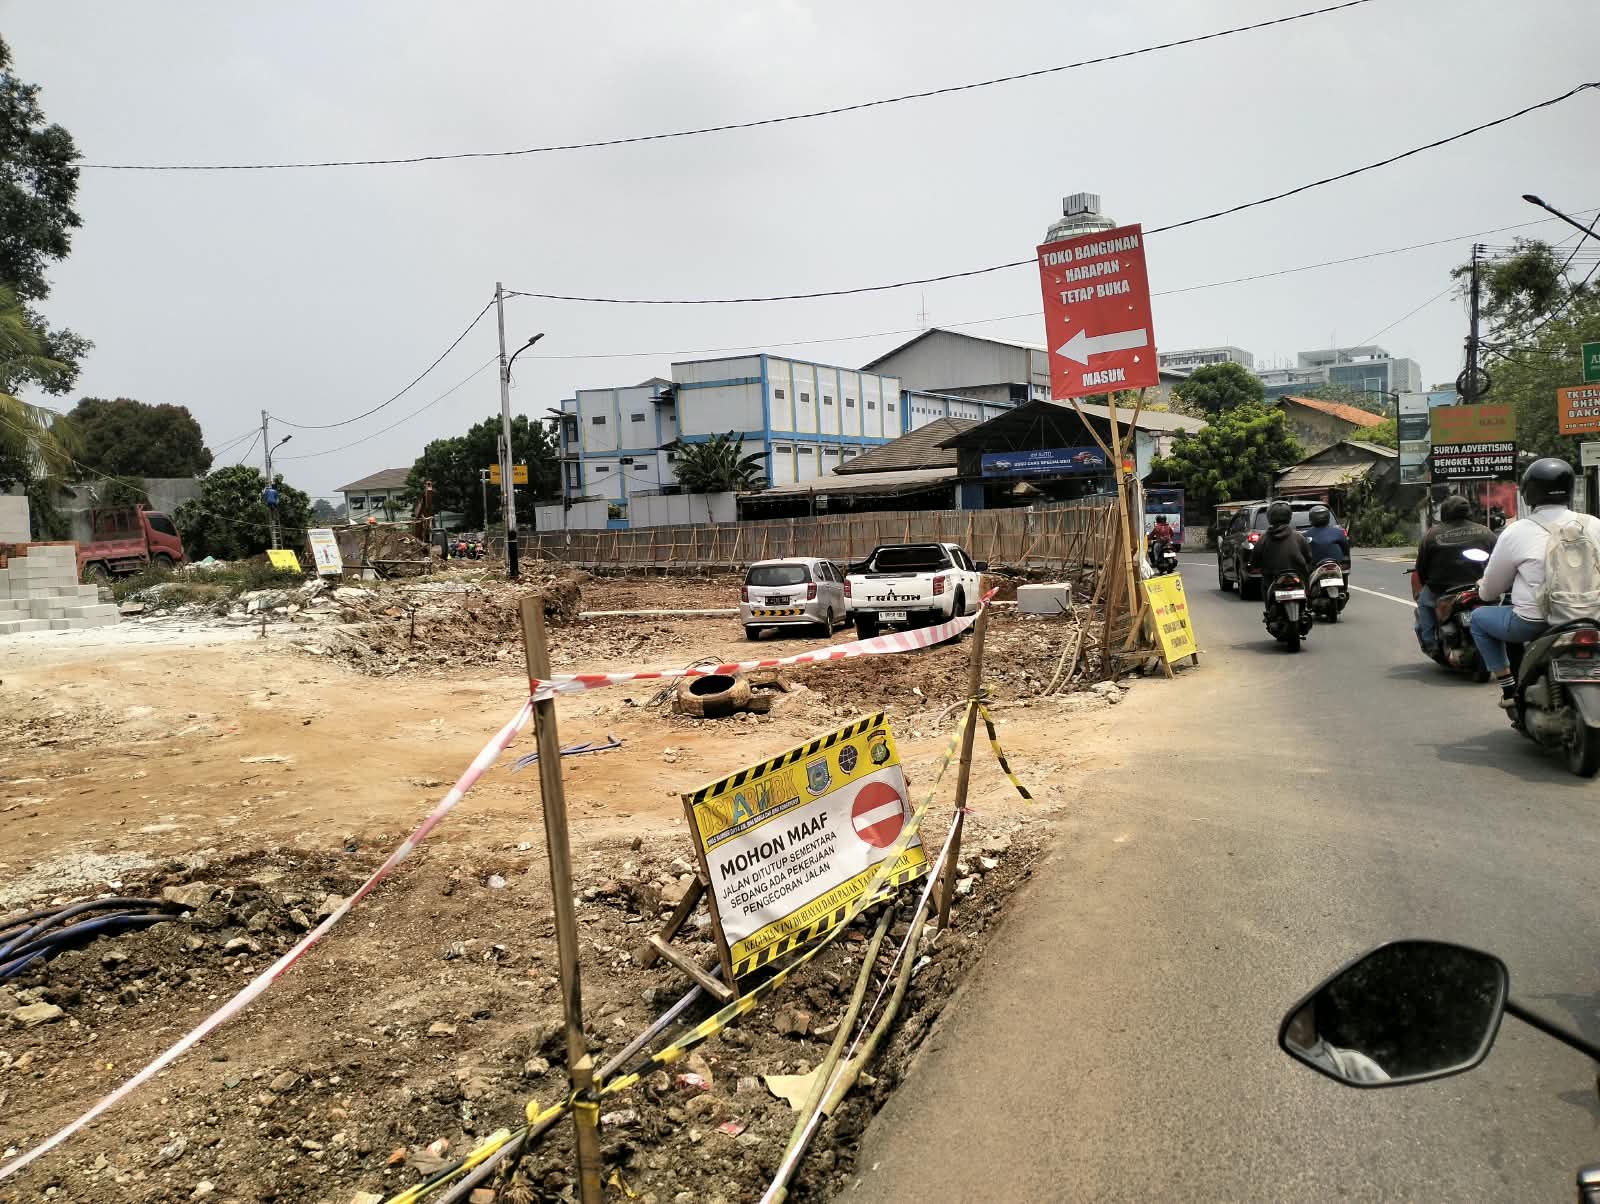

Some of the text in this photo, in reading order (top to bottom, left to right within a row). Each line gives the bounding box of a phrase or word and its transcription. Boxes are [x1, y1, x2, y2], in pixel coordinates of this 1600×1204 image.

[1042, 236, 1138, 266] TOKO BANGUNAN
[1066, 260, 1120, 282] HARAPAN
[1060, 280, 1130, 304] TETAP BUKA
[1082, 368, 1126, 386] MASUK
[1434, 445, 1460, 454] SURYA
[1434, 456, 1512, 466] BENGKEL REKLAME
[720, 835, 786, 880] MOHON
[787, 812, 828, 846] MAAF
[723, 831, 836, 899] JALAN DITUTUP SEMENTARA
[731, 845, 835, 908] SEDANG ADA PEKERJAAN
[743, 862, 830, 916] PENGECORAN JALAN
[744, 924, 781, 952] KEGIATAN
[780, 921, 793, 934] INI
[822, 895, 838, 911] DARI
[838, 884, 859, 904] PAJAK
